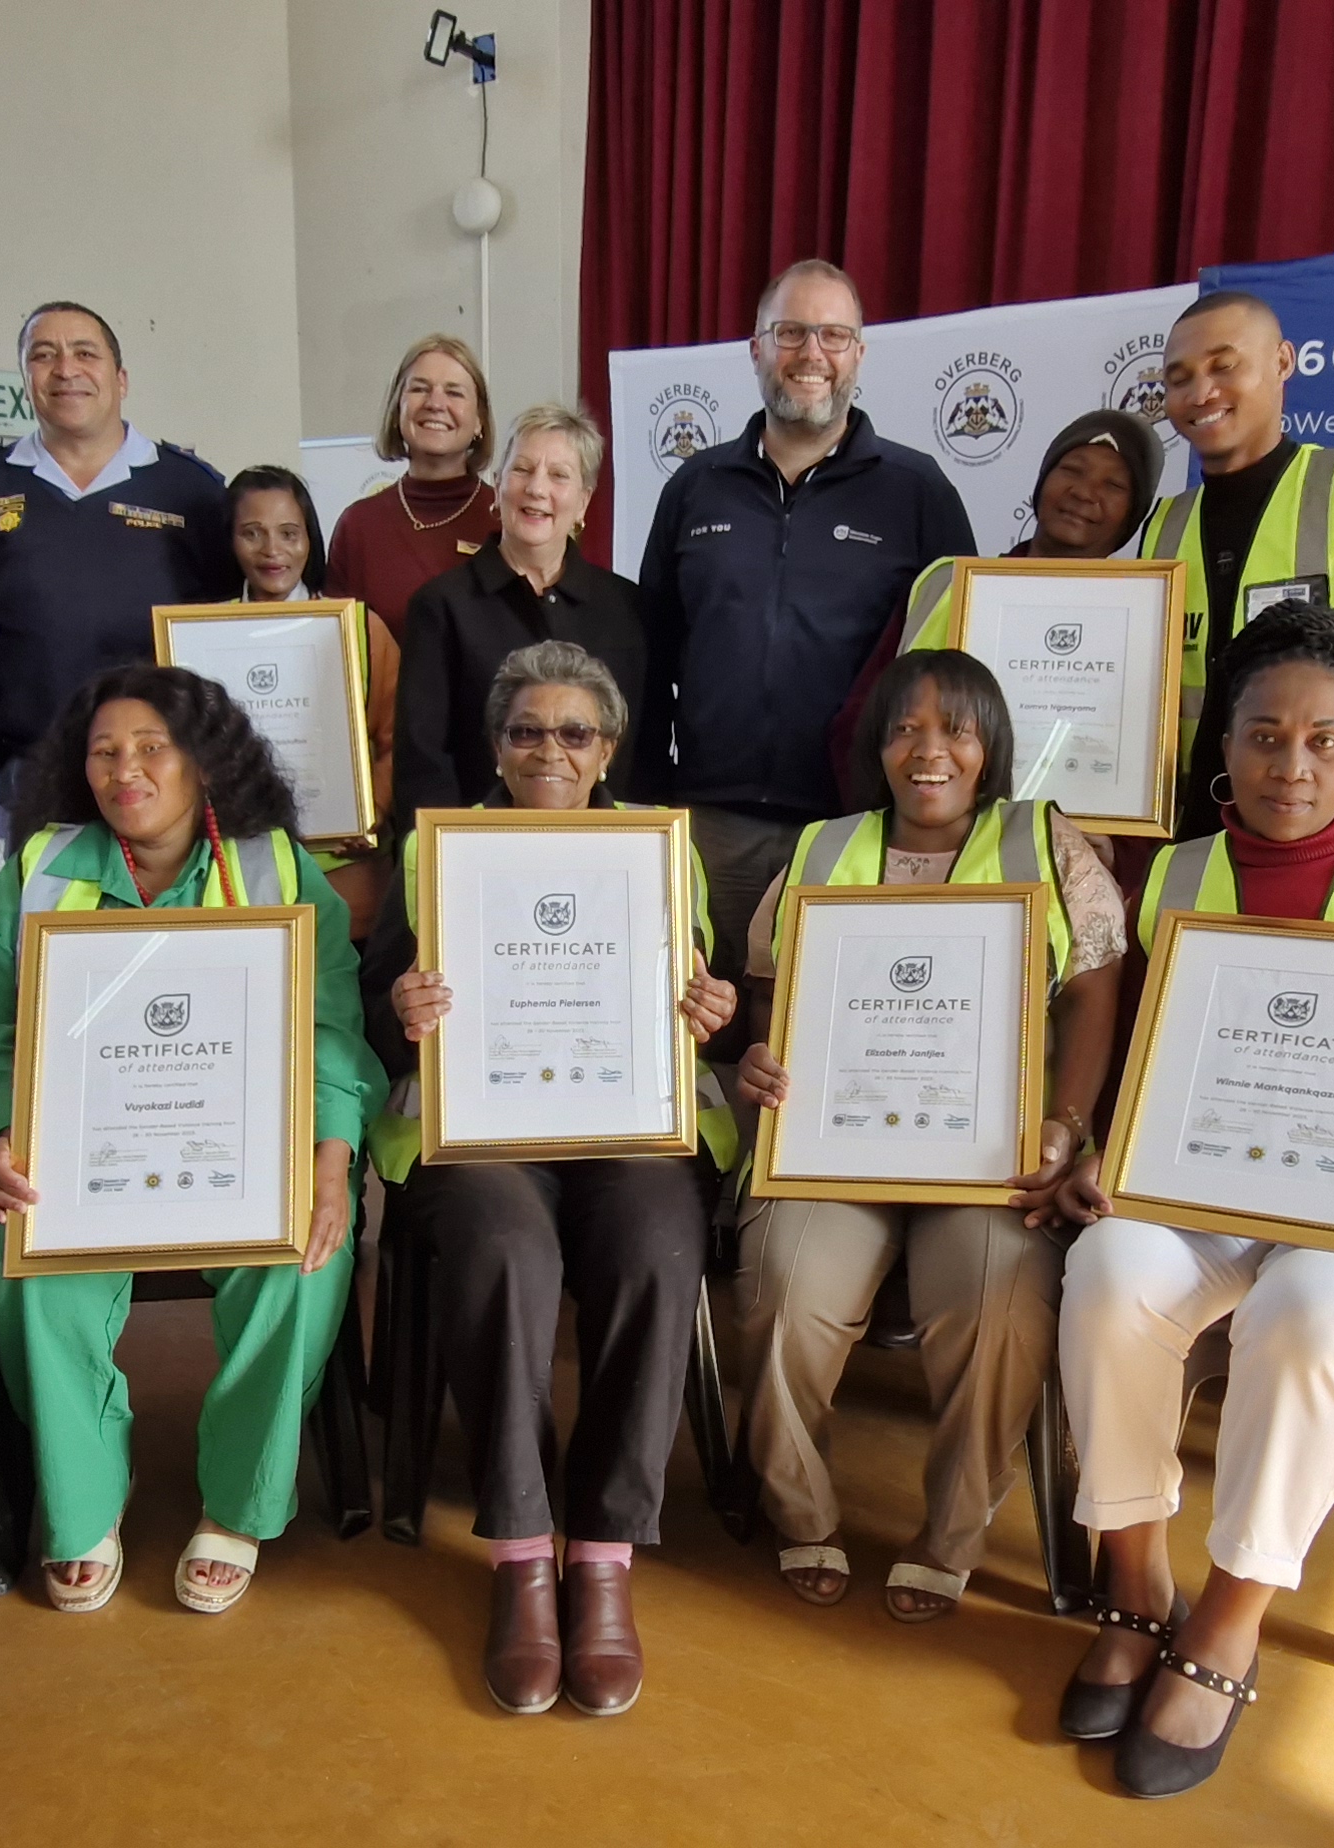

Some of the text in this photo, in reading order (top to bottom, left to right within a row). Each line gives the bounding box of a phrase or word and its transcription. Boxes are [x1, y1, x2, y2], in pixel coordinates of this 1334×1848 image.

[1104, 333, 1165, 374] OVERB
[935, 351, 1022, 391] OVERBERG
[649, 383, 719, 415] OVERBERG
[710, 523, 732, 533] YOU
[1008, 659, 1116, 672] CERTIFICATE
[1037, 675, 1101, 684] attendance
[239, 697, 311, 711] RTIFICATE
[493, 942, 616, 956] CERTIFICATE
[511, 960, 601, 971] of attendance
[509, 999, 557, 1009] Euphemia
[848, 998, 972, 1011] CERTIFICATE
[864, 1015, 955, 1025] of attendance
[99, 1040, 234, 1059] CERTIFICATE
[865, 1048, 946, 1059] Elizabeth Jantjies
[1233, 1045, 1248, 1054] of
[118, 1060, 215, 1074] of attendance
[1216, 1076, 1252, 1089] Winnie
[124, 1099, 206, 1113] Vuyokazi Ludidi
